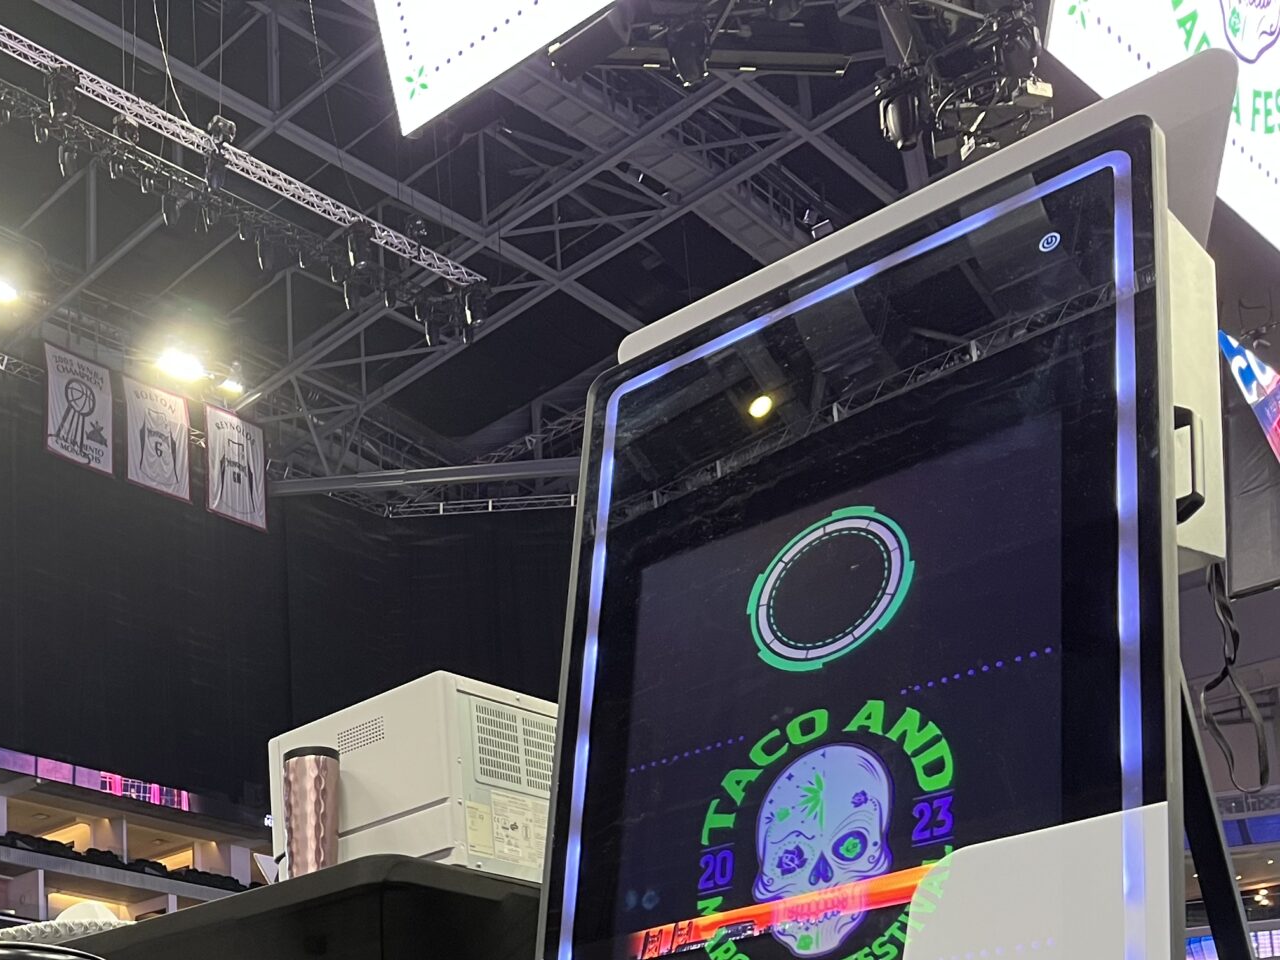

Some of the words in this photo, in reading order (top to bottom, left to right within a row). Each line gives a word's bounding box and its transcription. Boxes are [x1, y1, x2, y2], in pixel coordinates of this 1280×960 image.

[1250, 88, 1280, 134] FE
[700, 708, 829, 846] TACO
[841, 699, 954, 792] AND
[911, 796, 954, 841] 23
[697, 850, 735, 890] 20
